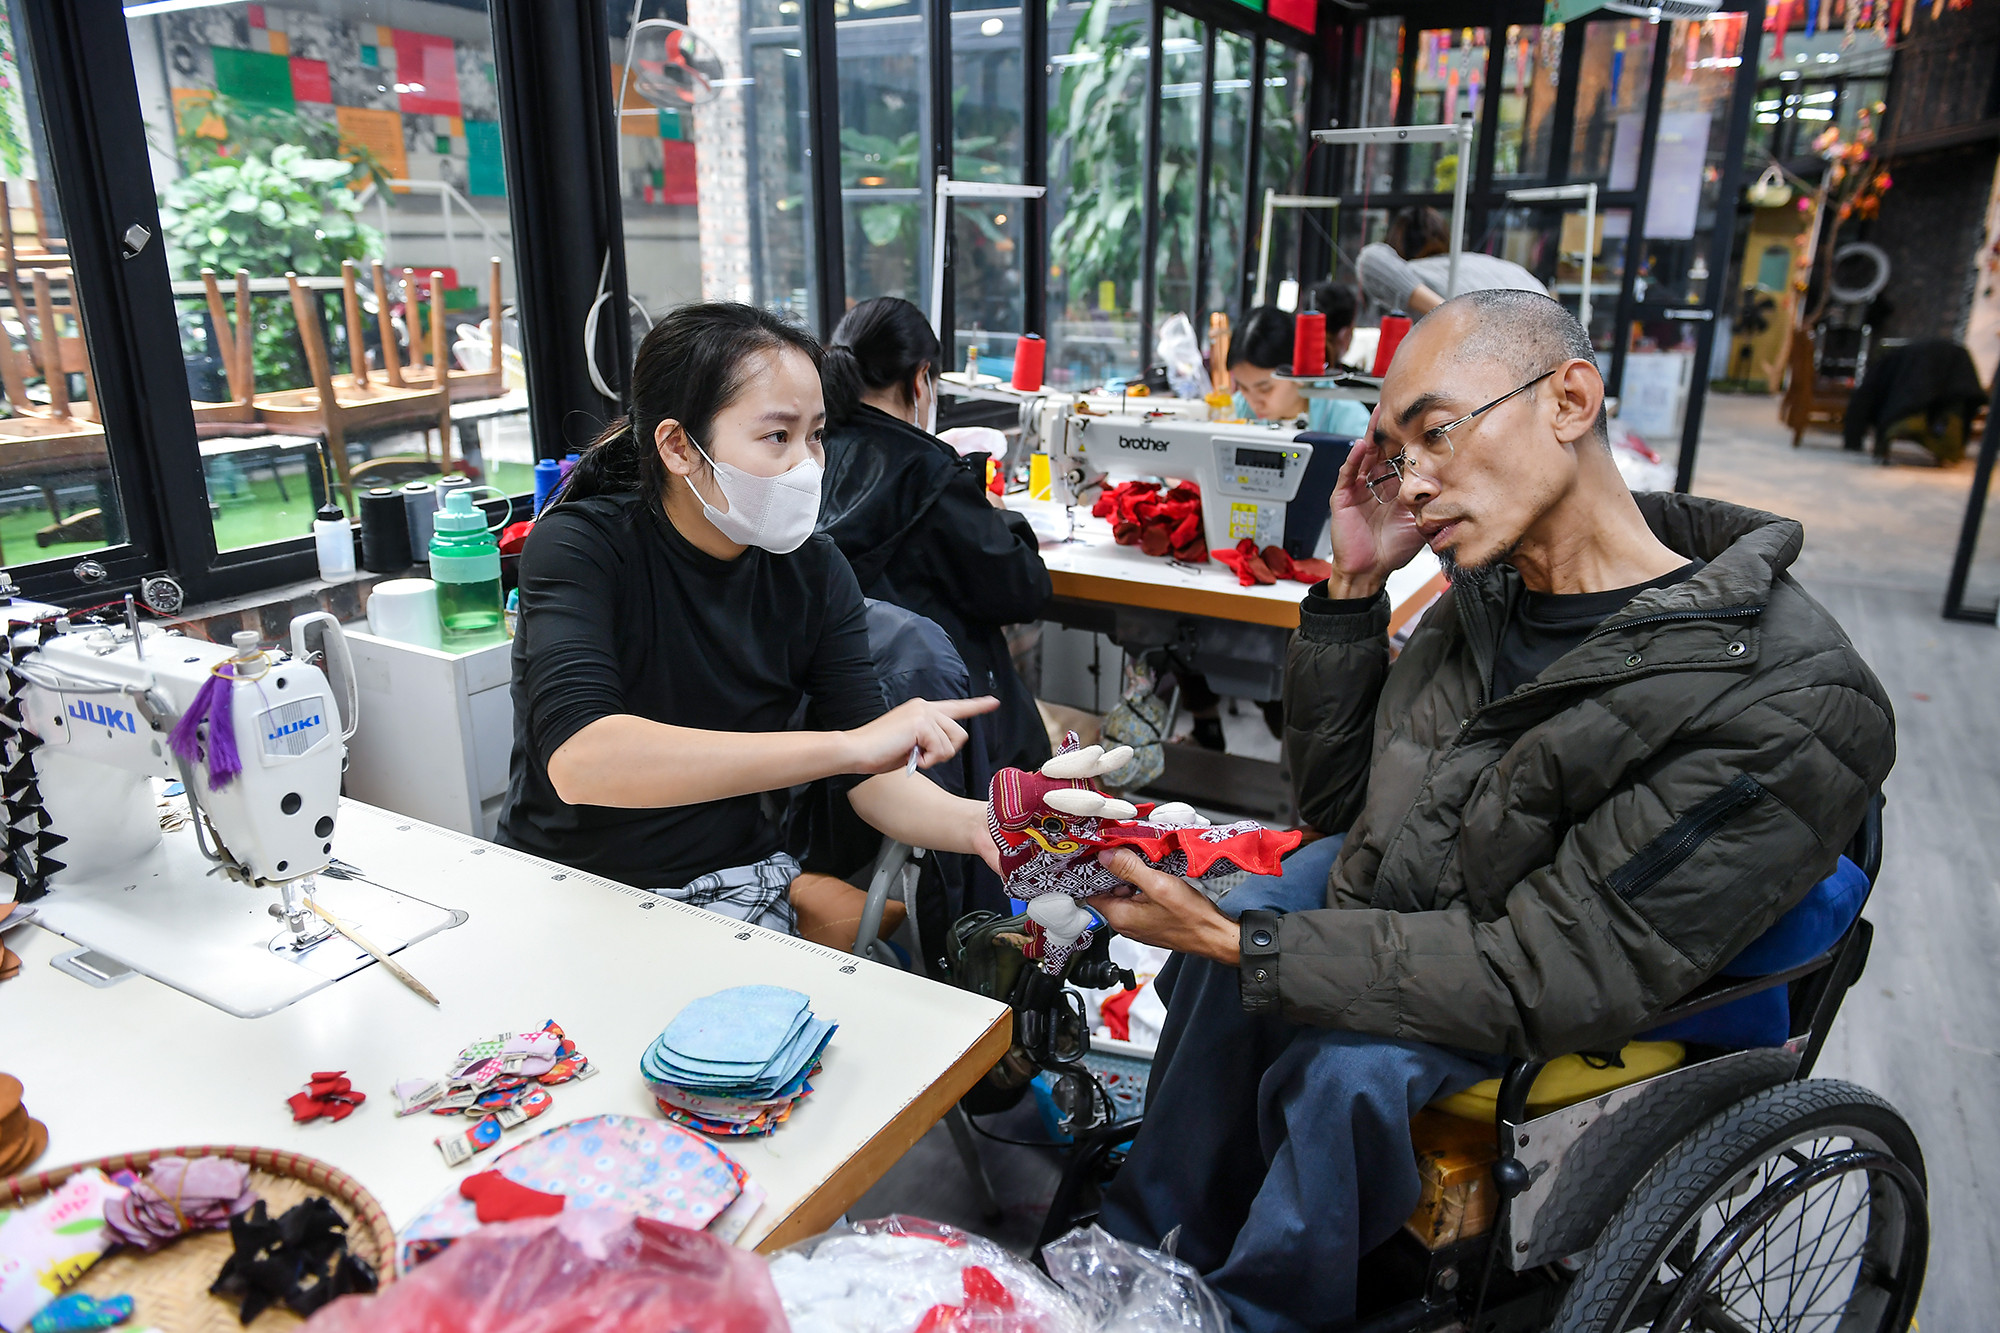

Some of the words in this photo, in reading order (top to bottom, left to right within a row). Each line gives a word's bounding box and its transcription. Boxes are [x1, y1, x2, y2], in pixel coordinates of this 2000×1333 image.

[1119, 435, 1170, 452] brother
[68, 699, 136, 734] JUKI
[268, 714, 321, 740] JUKI
